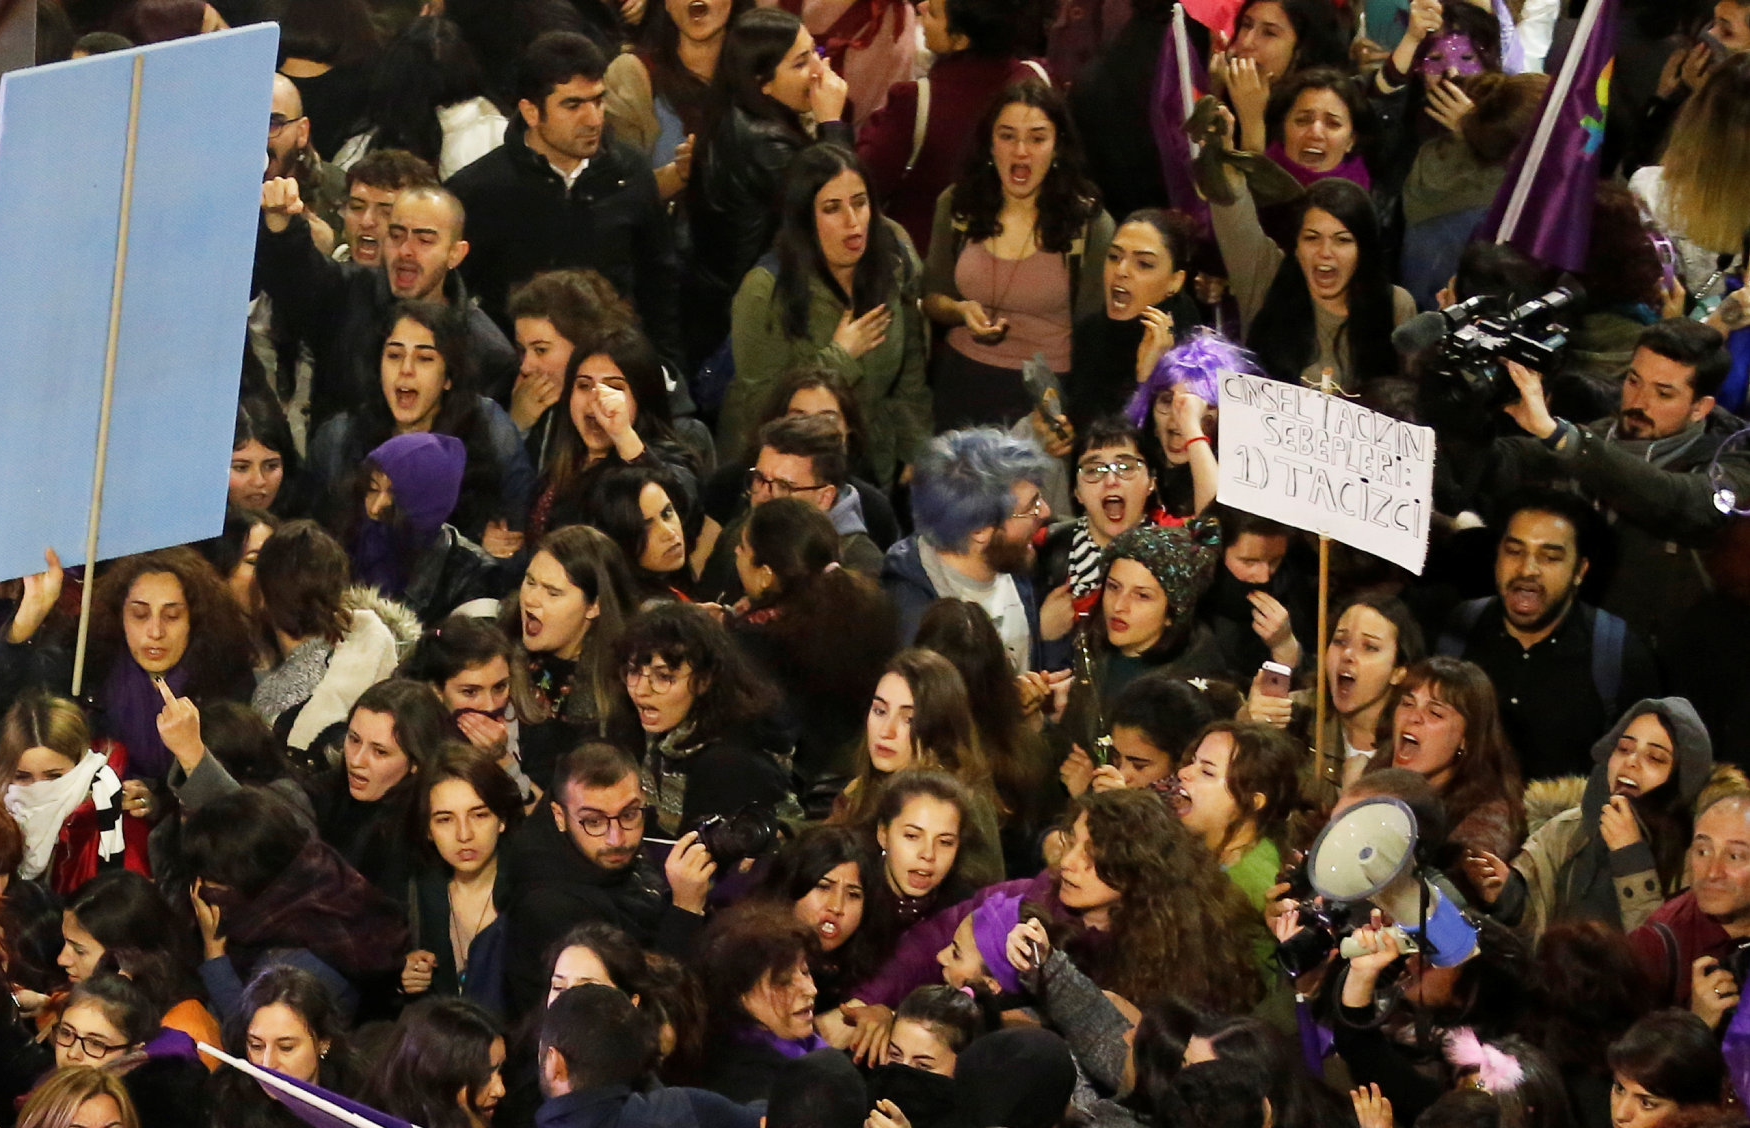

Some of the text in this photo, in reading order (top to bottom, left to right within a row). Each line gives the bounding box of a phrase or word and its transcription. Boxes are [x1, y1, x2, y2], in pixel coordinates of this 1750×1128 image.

[1223, 374, 1313, 425] CİNSEL
[1260, 414, 1412, 488] SEBEPLERİ:
[1274, 455, 1422, 539] TACİZCİ
